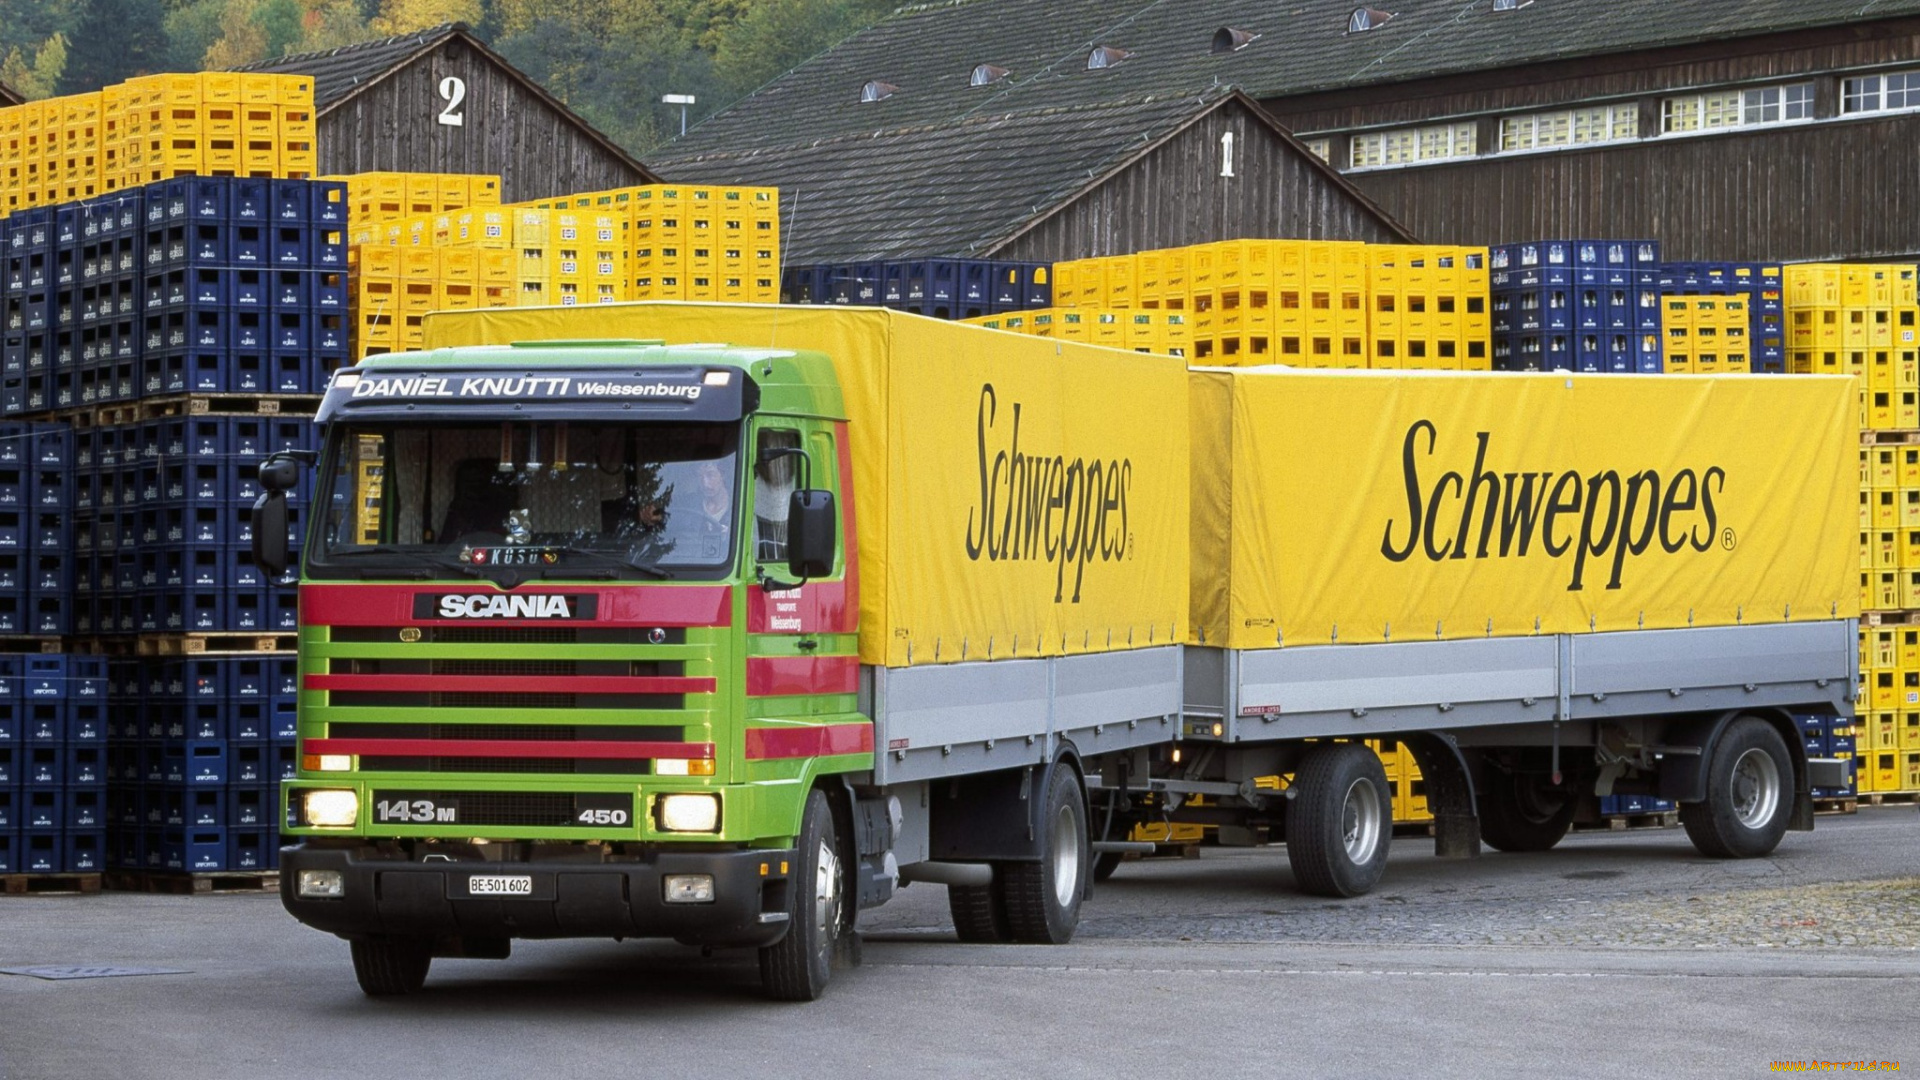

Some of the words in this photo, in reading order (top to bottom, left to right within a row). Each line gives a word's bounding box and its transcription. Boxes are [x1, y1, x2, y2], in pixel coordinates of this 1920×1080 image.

[439, 77, 466, 126] 2
[1220, 132, 1235, 177] 1
[352, 378, 453, 397] DANIEL
[460, 378, 570, 396] KNUTTI
[577, 382, 701, 399] Weissenburg
[966, 383, 1132, 603] Schweppes
[1380, 419, 1726, 591] Schweppes
[439, 594, 571, 618] SCANIA
[578, 809, 627, 825] 450
